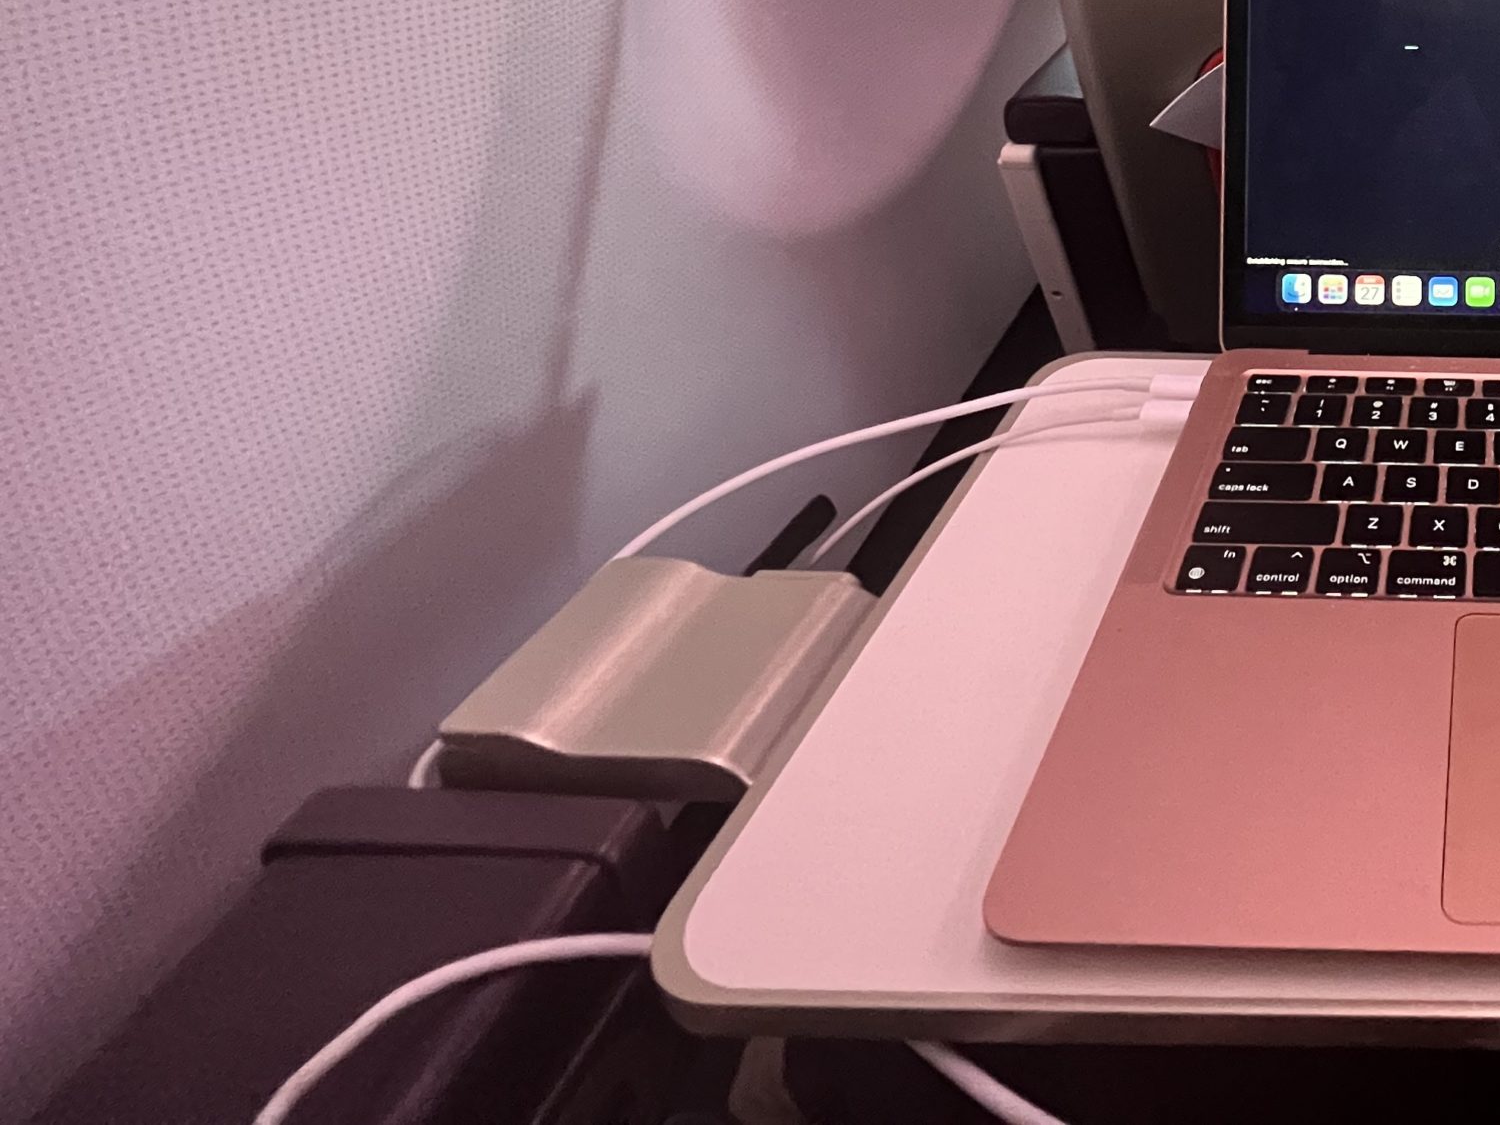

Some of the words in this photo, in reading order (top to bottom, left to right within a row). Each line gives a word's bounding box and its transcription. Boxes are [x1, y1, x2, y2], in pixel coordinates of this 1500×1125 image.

[1361, 287, 1379, 300] 27
[1316, 409, 1323, 418] 1
[1371, 411, 1381, 420] 2
[1428, 412, 1438, 421] 3
[1485, 413, 1495, 422] 4
[1231, 445, 1249, 454] tab
[1335, 438, 1347, 450] Q
[1393, 439, 1409, 450] W
[1455, 441, 1465, 452] E
[1342, 476, 1355, 488] A
[1406, 477, 1417, 489] S
[1468, 478, 1479, 490] D
[1218, 483, 1244, 493] caps
[1246, 483, 1269, 492] lock
[1203, 524, 1231, 534] shift
[1367, 517, 1380, 530] Z
[1433, 519, 1446, 532] X
[1223, 549, 1236, 559] fn
[1256, 573, 1300, 583] control
[1329, 574, 1369, 585] option
[1396, 575, 1457, 587] command
